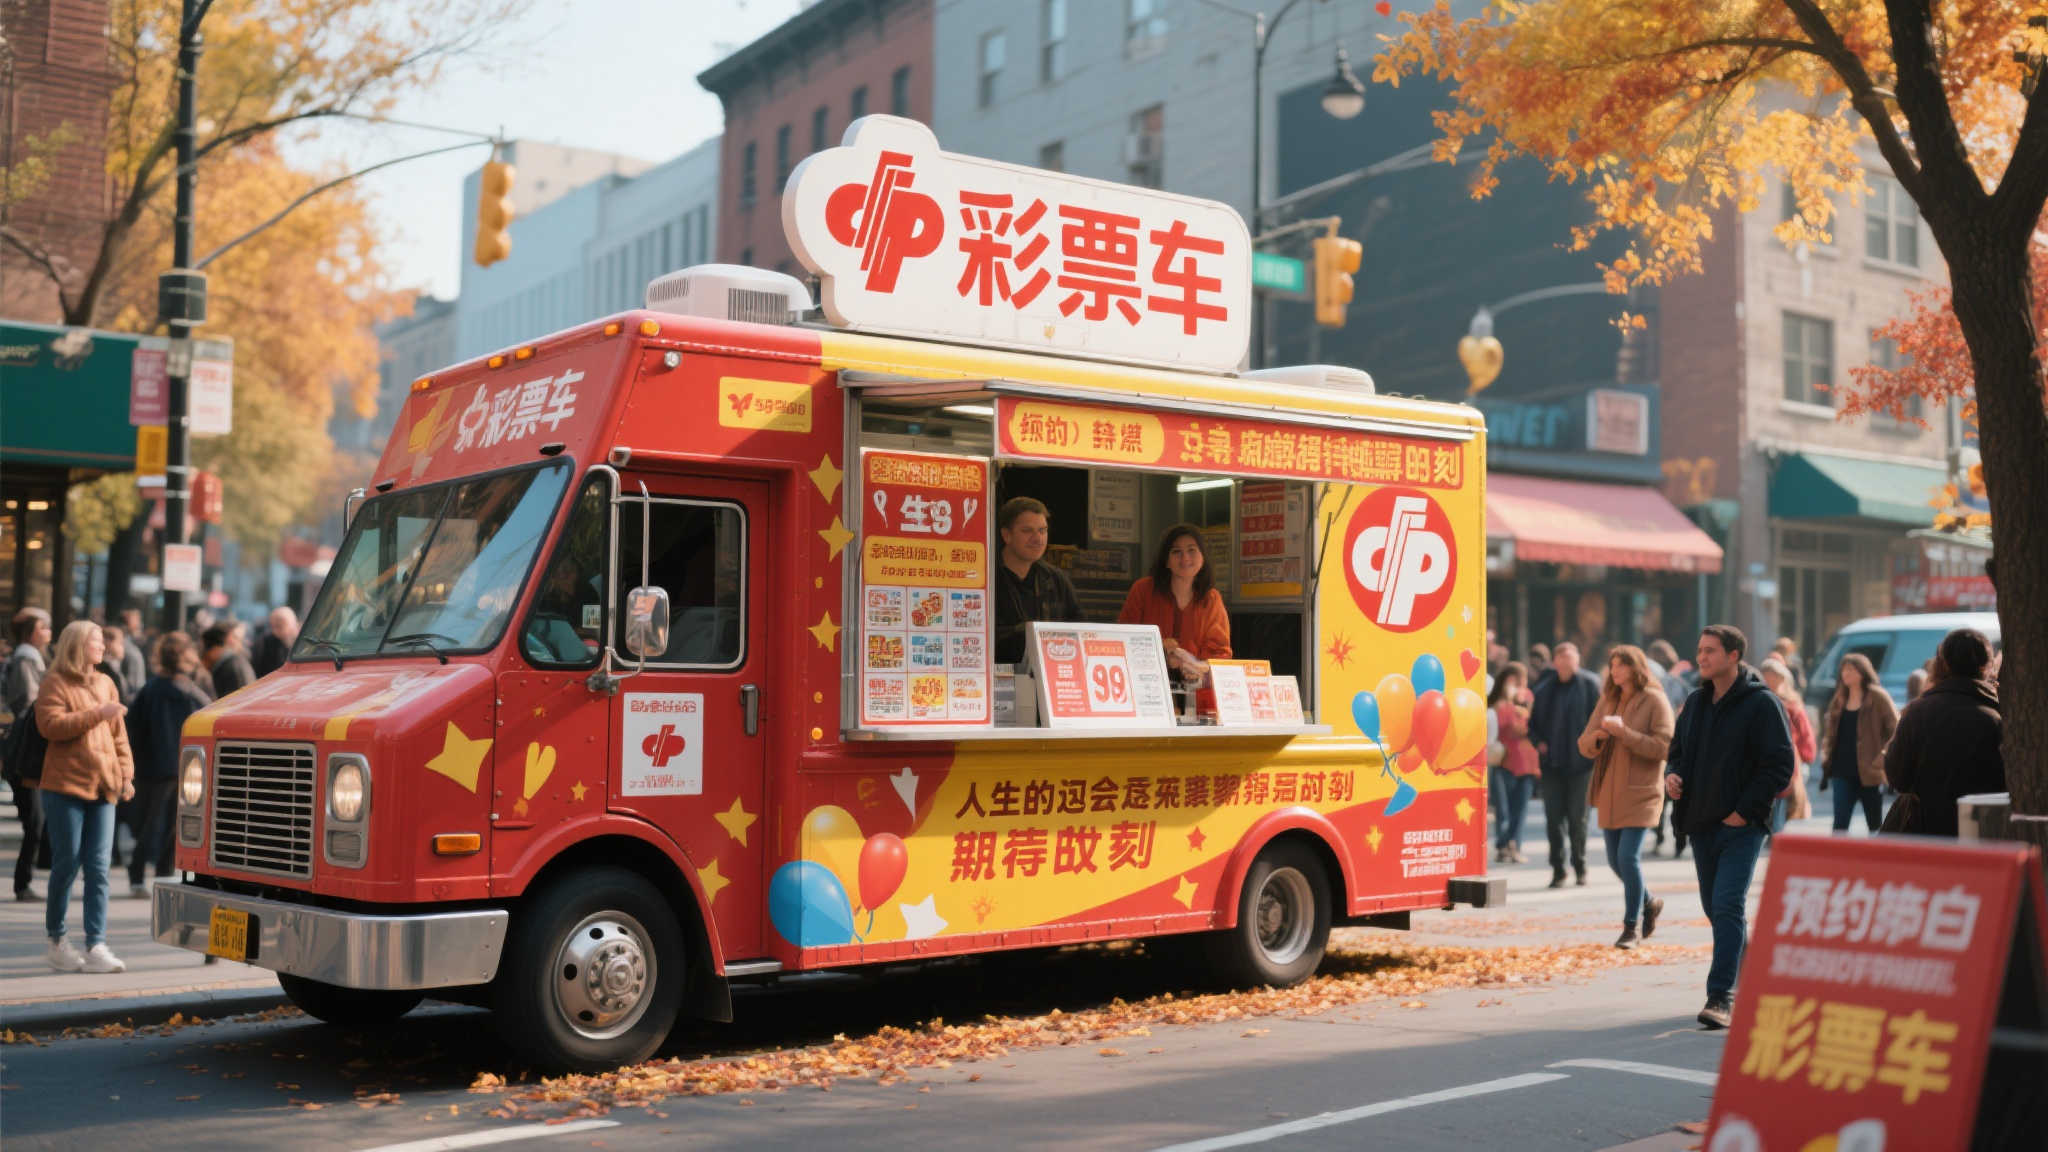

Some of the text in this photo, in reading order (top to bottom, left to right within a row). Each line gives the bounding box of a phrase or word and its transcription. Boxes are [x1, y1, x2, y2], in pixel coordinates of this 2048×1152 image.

[957, 190, 1228, 336] 彩票车
[478, 368, 585, 449] 彩票车
[1740, 994, 1960, 1105] 彩票车
